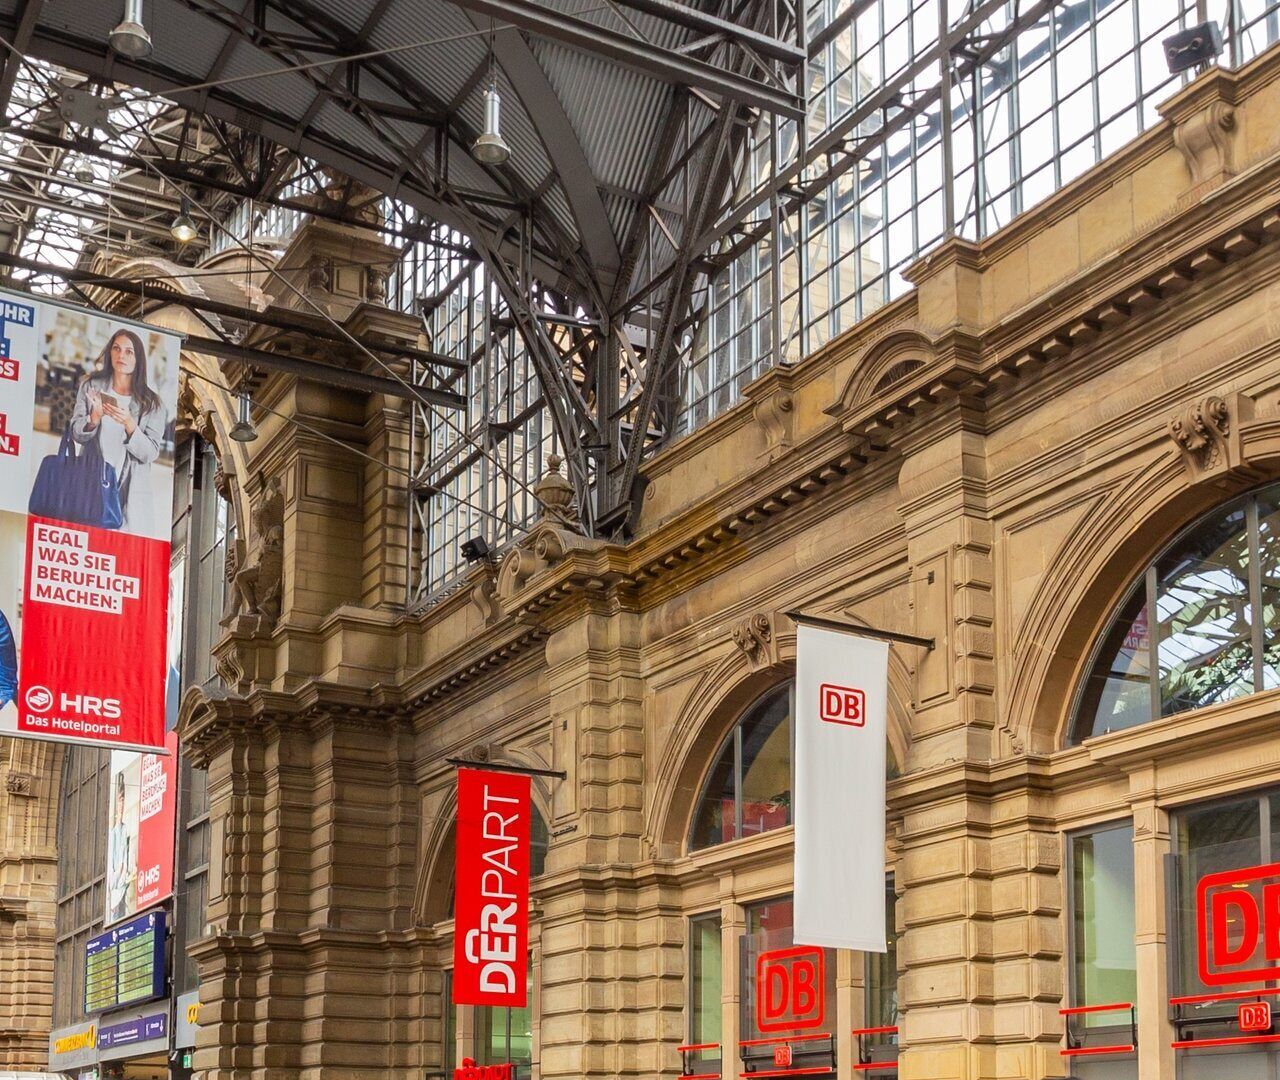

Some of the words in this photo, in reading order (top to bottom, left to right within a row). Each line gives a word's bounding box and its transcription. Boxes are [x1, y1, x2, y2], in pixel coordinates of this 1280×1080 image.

[37, 528, 84, 549] EGAL
[37, 546, 80, 567] WAS
[83, 552, 112, 572] SIE
[37, 565, 135, 596] BERUFLICH
[36, 583, 119, 611] MACHEN:
[60, 693, 122, 718] HRS
[825, 690, 861, 720] DB
[26, 713, 49, 728] Das
[51, 715, 121, 736] Hotelportal
[144, 864, 160, 887] HRS
[765, 959, 819, 1019] DB
[1241, 1007, 1270, 1028] DB
[774, 1047, 791, 1067] DB
